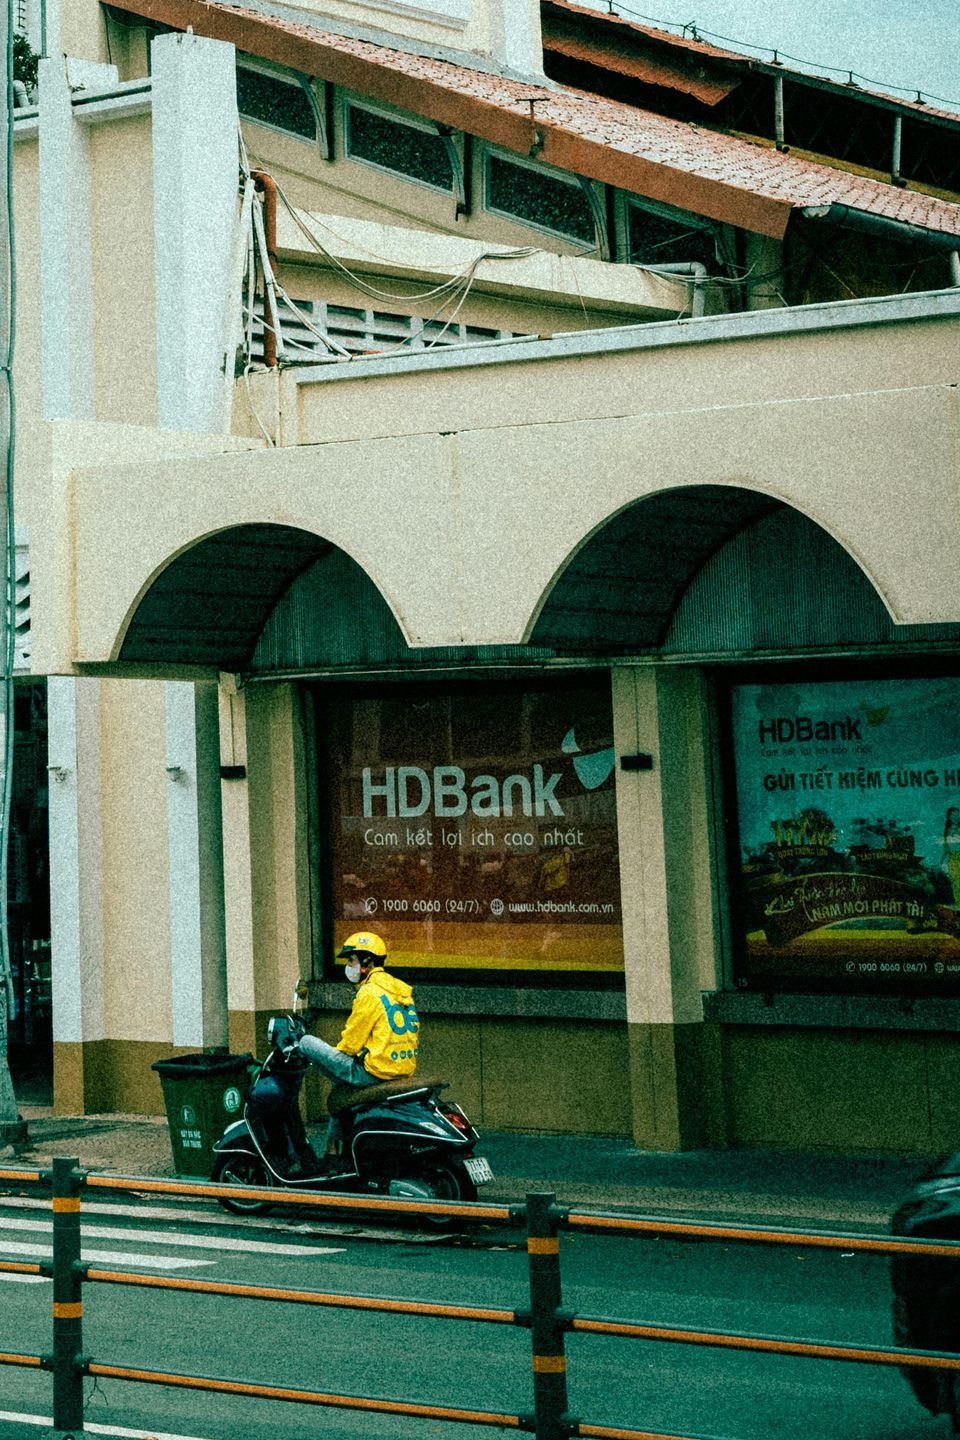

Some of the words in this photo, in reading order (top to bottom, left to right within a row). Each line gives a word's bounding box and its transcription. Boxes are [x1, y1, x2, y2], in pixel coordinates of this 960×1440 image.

[759, 717, 861, 743] HDBank
[363, 764, 565, 818] HDBank
[839, 767, 881, 792] KIỆM
[887, 767, 939, 788] CÙNG
[364, 829, 398, 846] Cam
[407, 828, 433, 846] kết
[442, 828, 462, 849] lợi
[472, 828, 495, 846] ích
[504, 833, 534, 846] cao
[544, 827, 584, 846] nhất
[383, 899, 408, 912] 1900
[413, 899, 440, 912] 6060
[445, 898, 480, 913] (24/7)
[509, 899, 614, 914] www.hdbank.com.vn
[858, 963, 877, 972] 1900
[380, 994, 419, 1035] be
